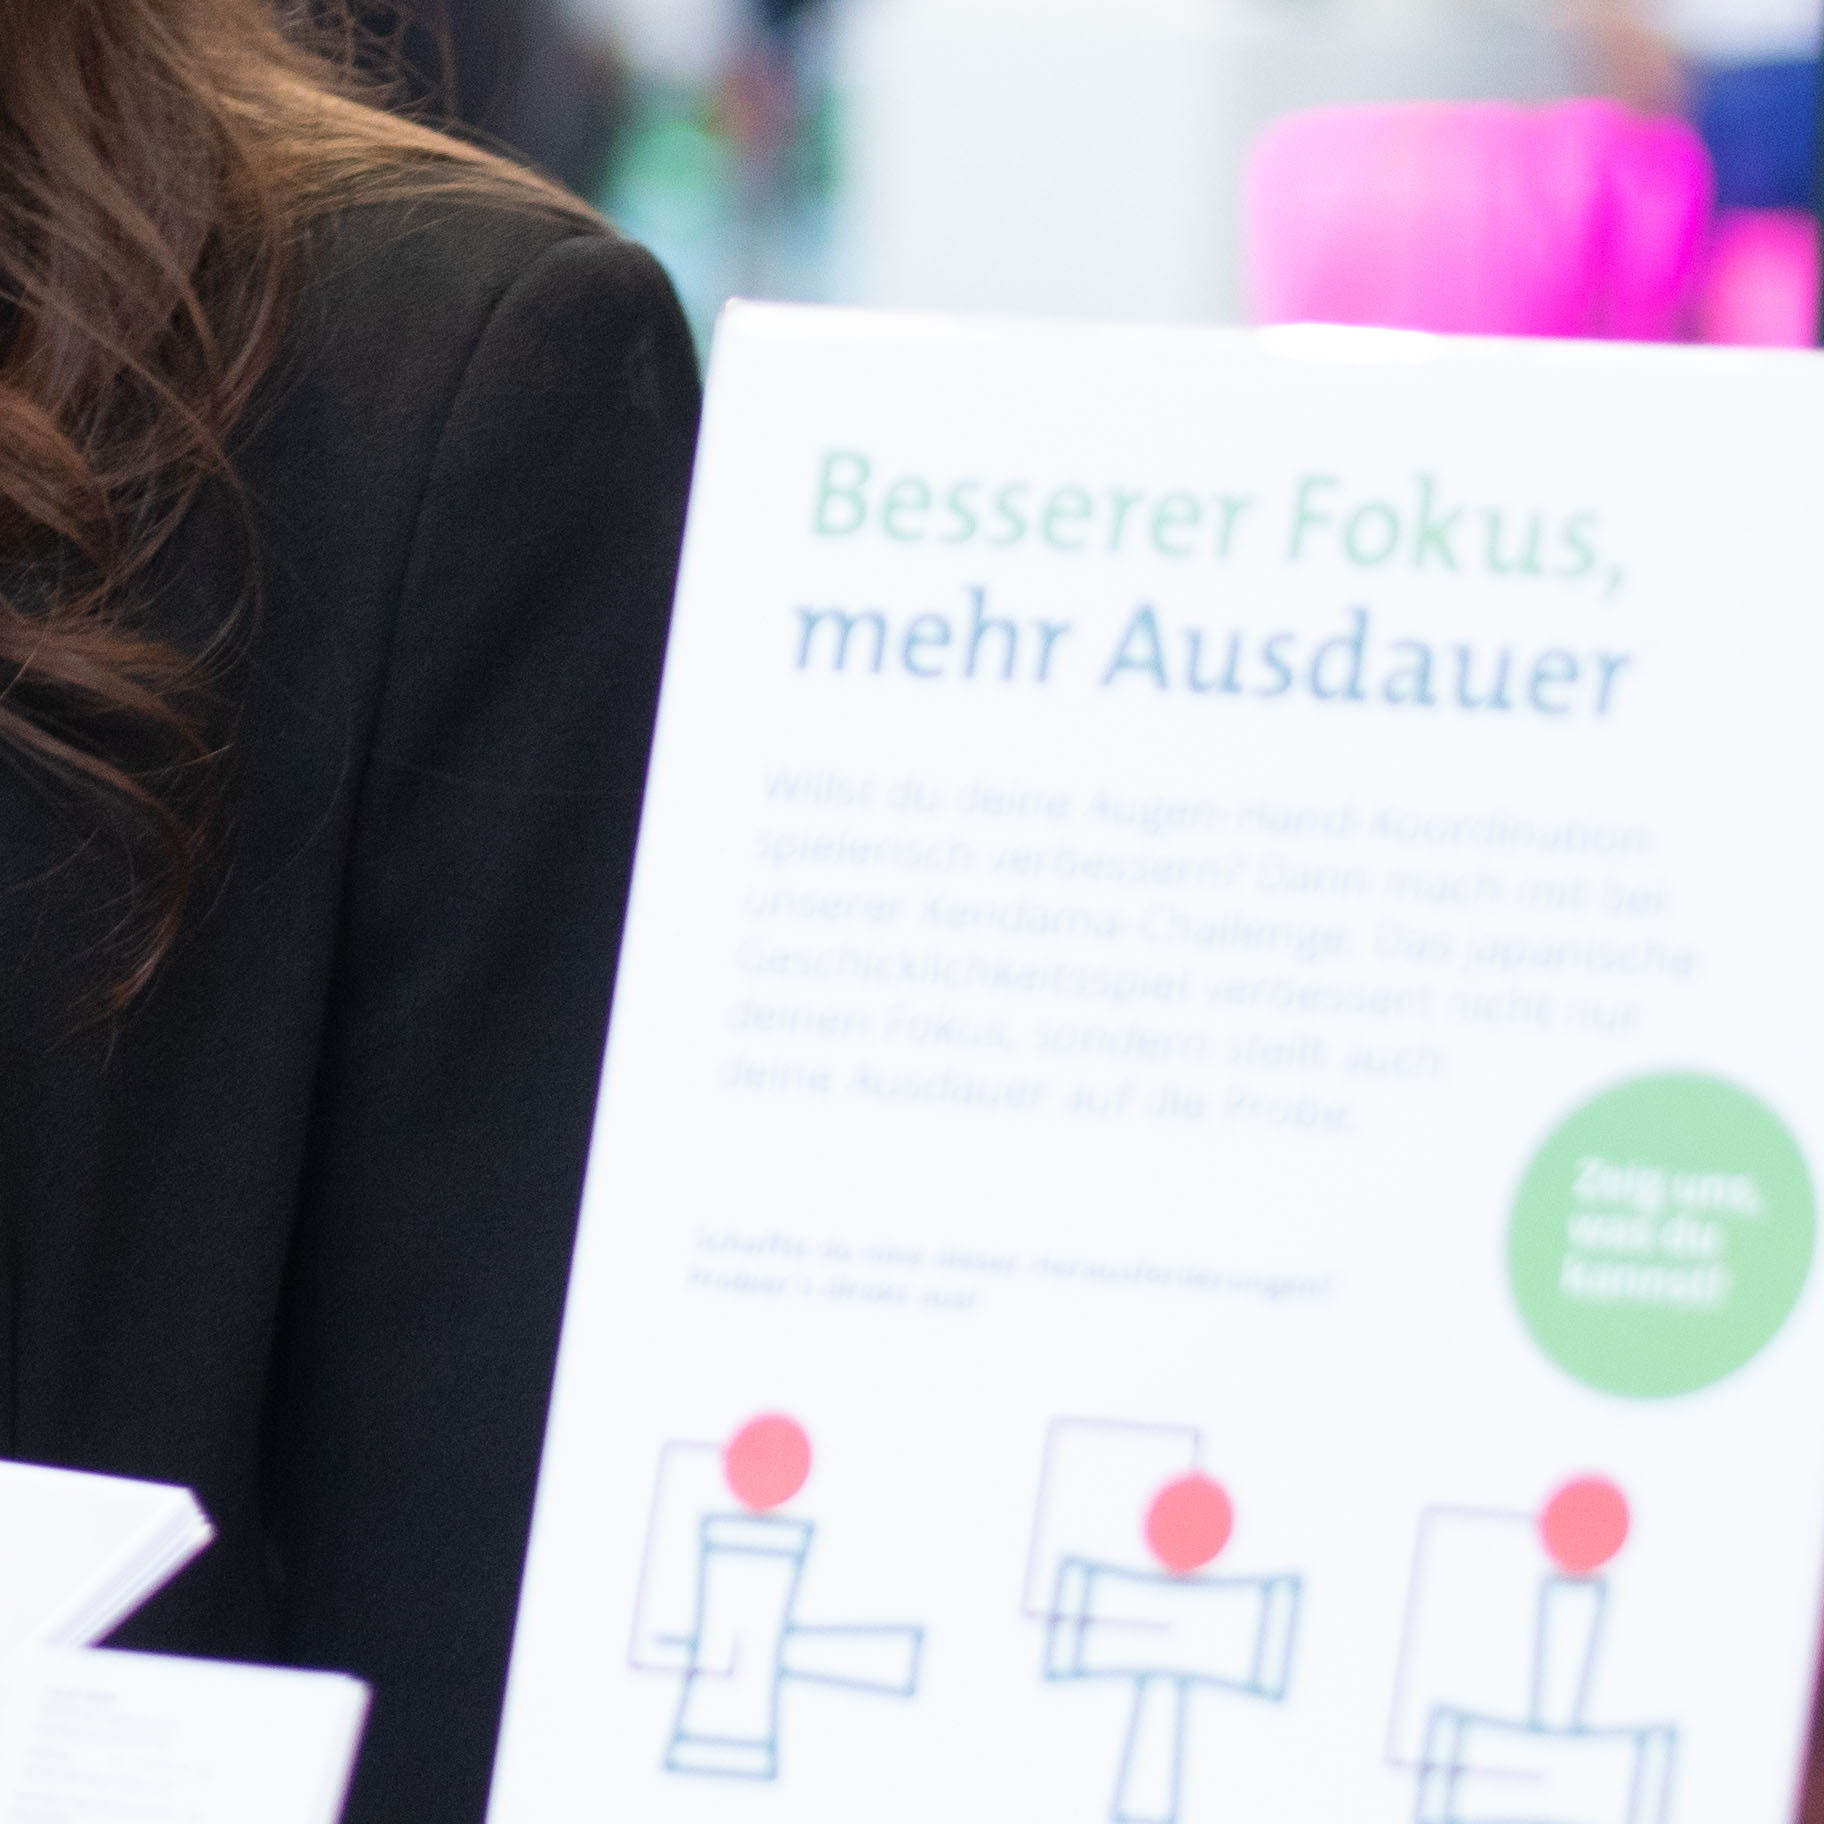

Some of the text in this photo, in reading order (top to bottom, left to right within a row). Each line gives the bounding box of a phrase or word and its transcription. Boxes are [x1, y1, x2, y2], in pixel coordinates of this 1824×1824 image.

[809, 447, 1631, 598] Besserer Fokus,
[792, 587, 1636, 718] mehr Ausdauer
